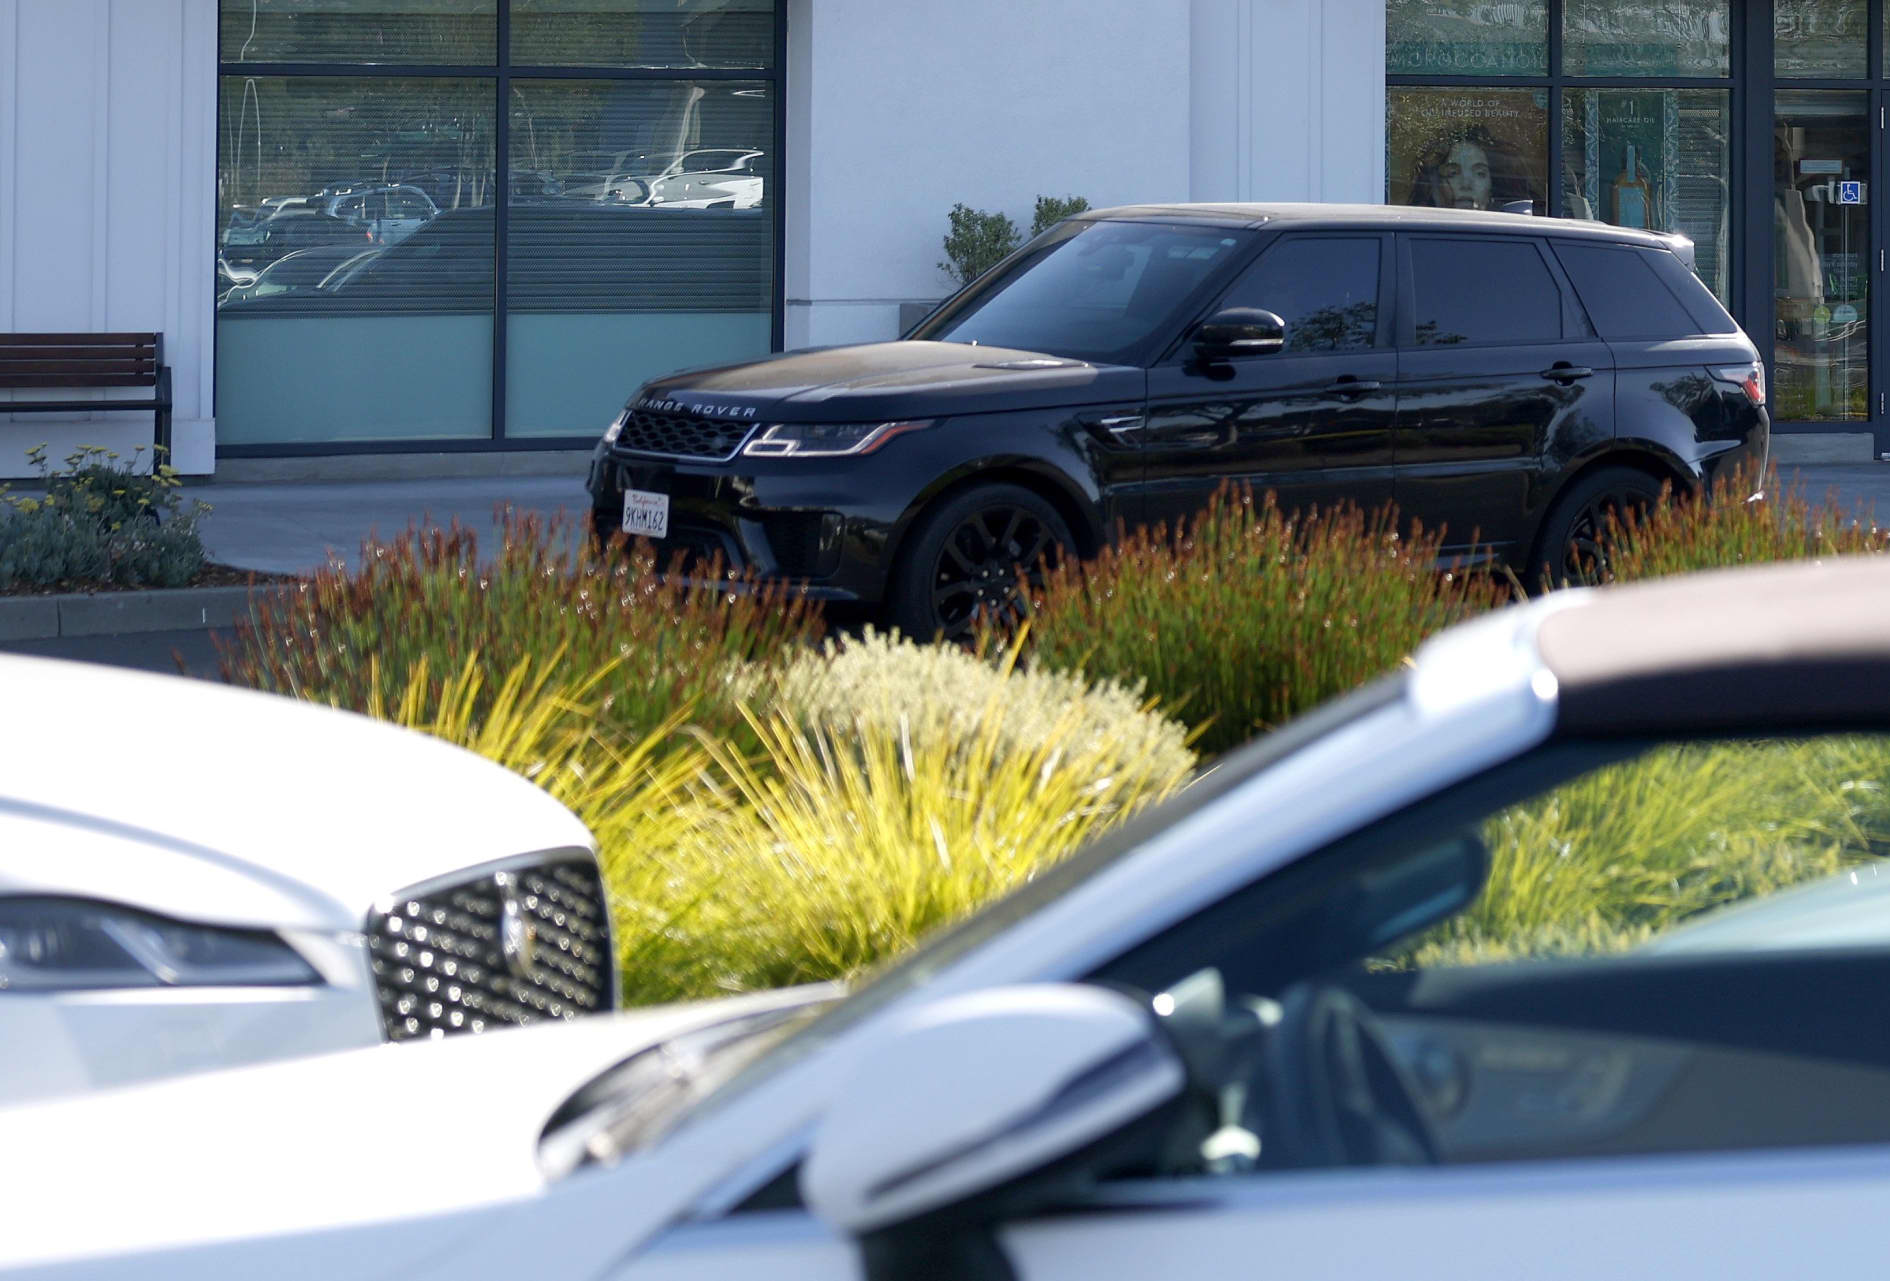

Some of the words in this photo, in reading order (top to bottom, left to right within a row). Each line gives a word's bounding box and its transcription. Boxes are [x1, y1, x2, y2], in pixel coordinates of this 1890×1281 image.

[638, 398, 684, 413] RANGE
[690, 403, 757, 418] ROVER
[624, 505, 665, 532] 9KHM162
